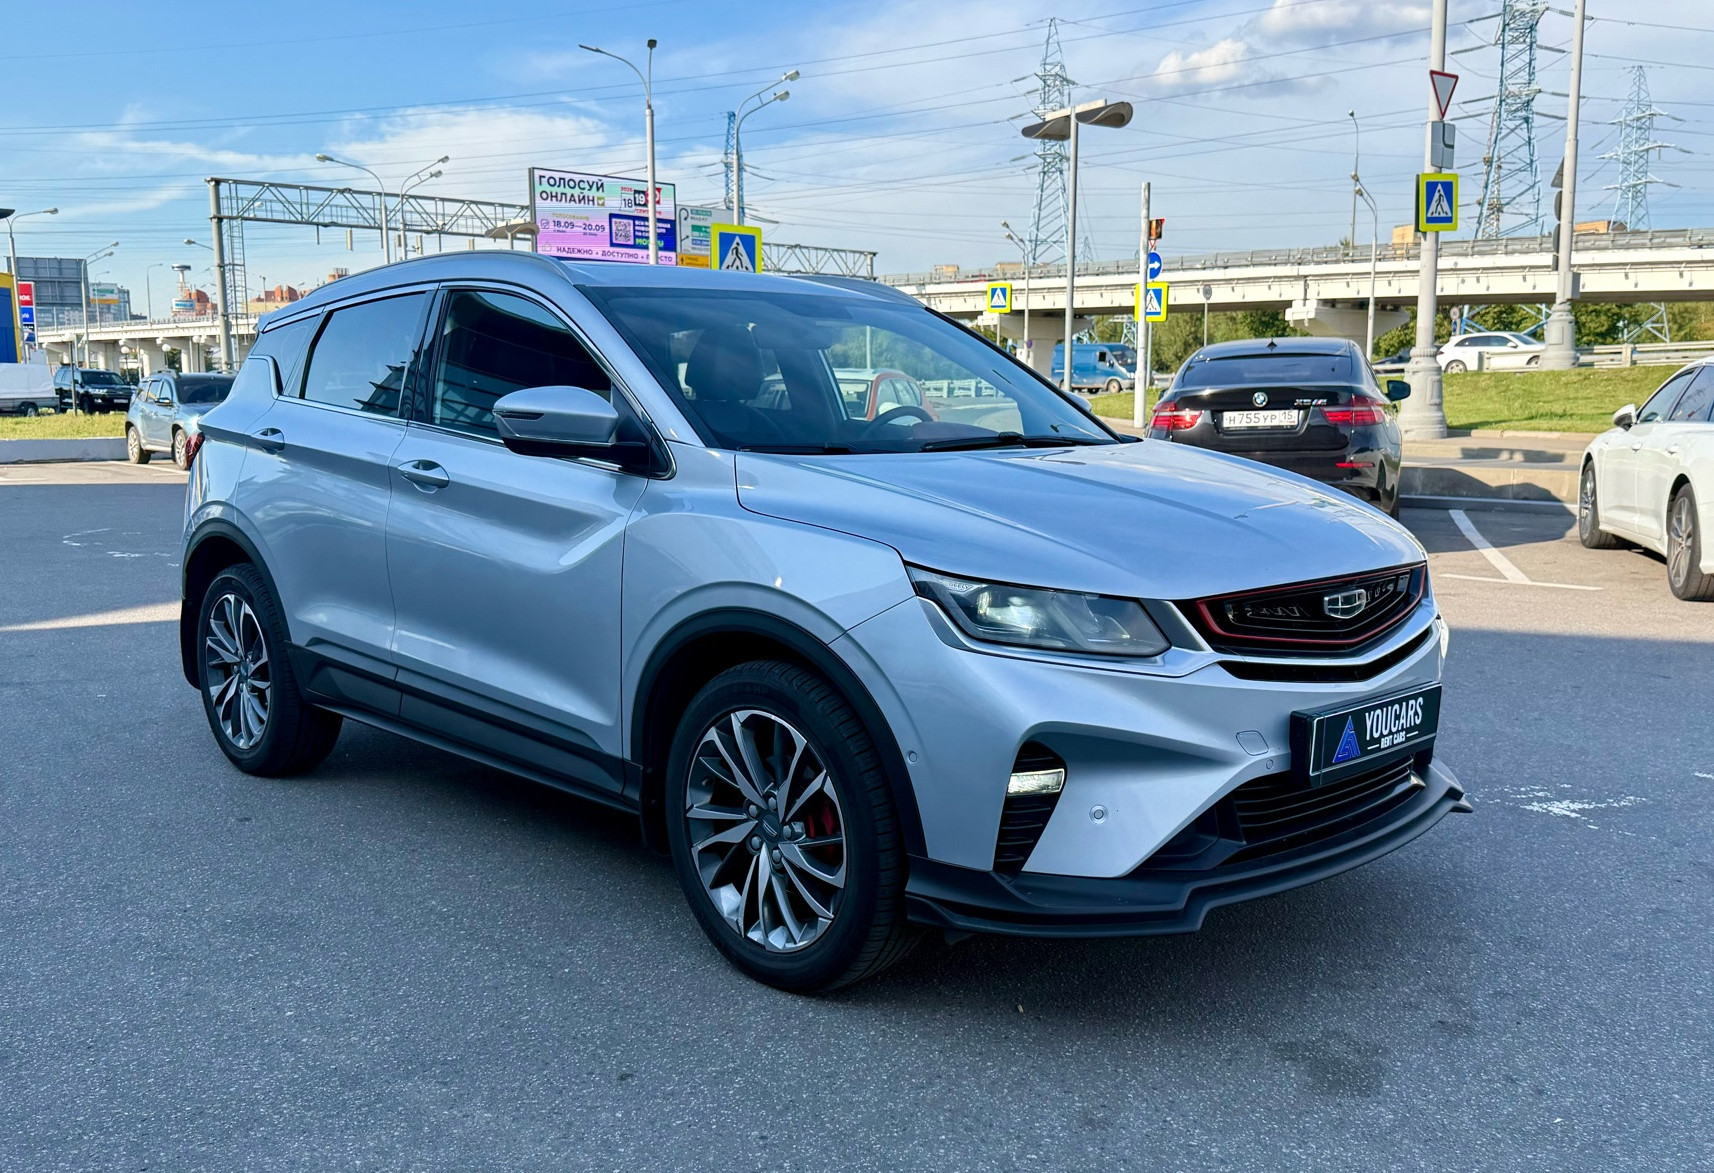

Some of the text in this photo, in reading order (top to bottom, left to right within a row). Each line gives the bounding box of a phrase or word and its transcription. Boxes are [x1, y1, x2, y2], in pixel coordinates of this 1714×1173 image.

[539, 175, 604, 193] ГОЛОСУЙ
[539, 190, 595, 206] ОНЛАЙН
[623, 198, 633, 208] 18
[635, 193, 645, 205] 19
[557, 246, 593, 255] НАДЕЖНО
[601, 250, 638, 260] ДОСТУПНО
[1365, 697, 1424, 741] YOUCARS
[1380, 731, 1406, 749] RENT CARS
